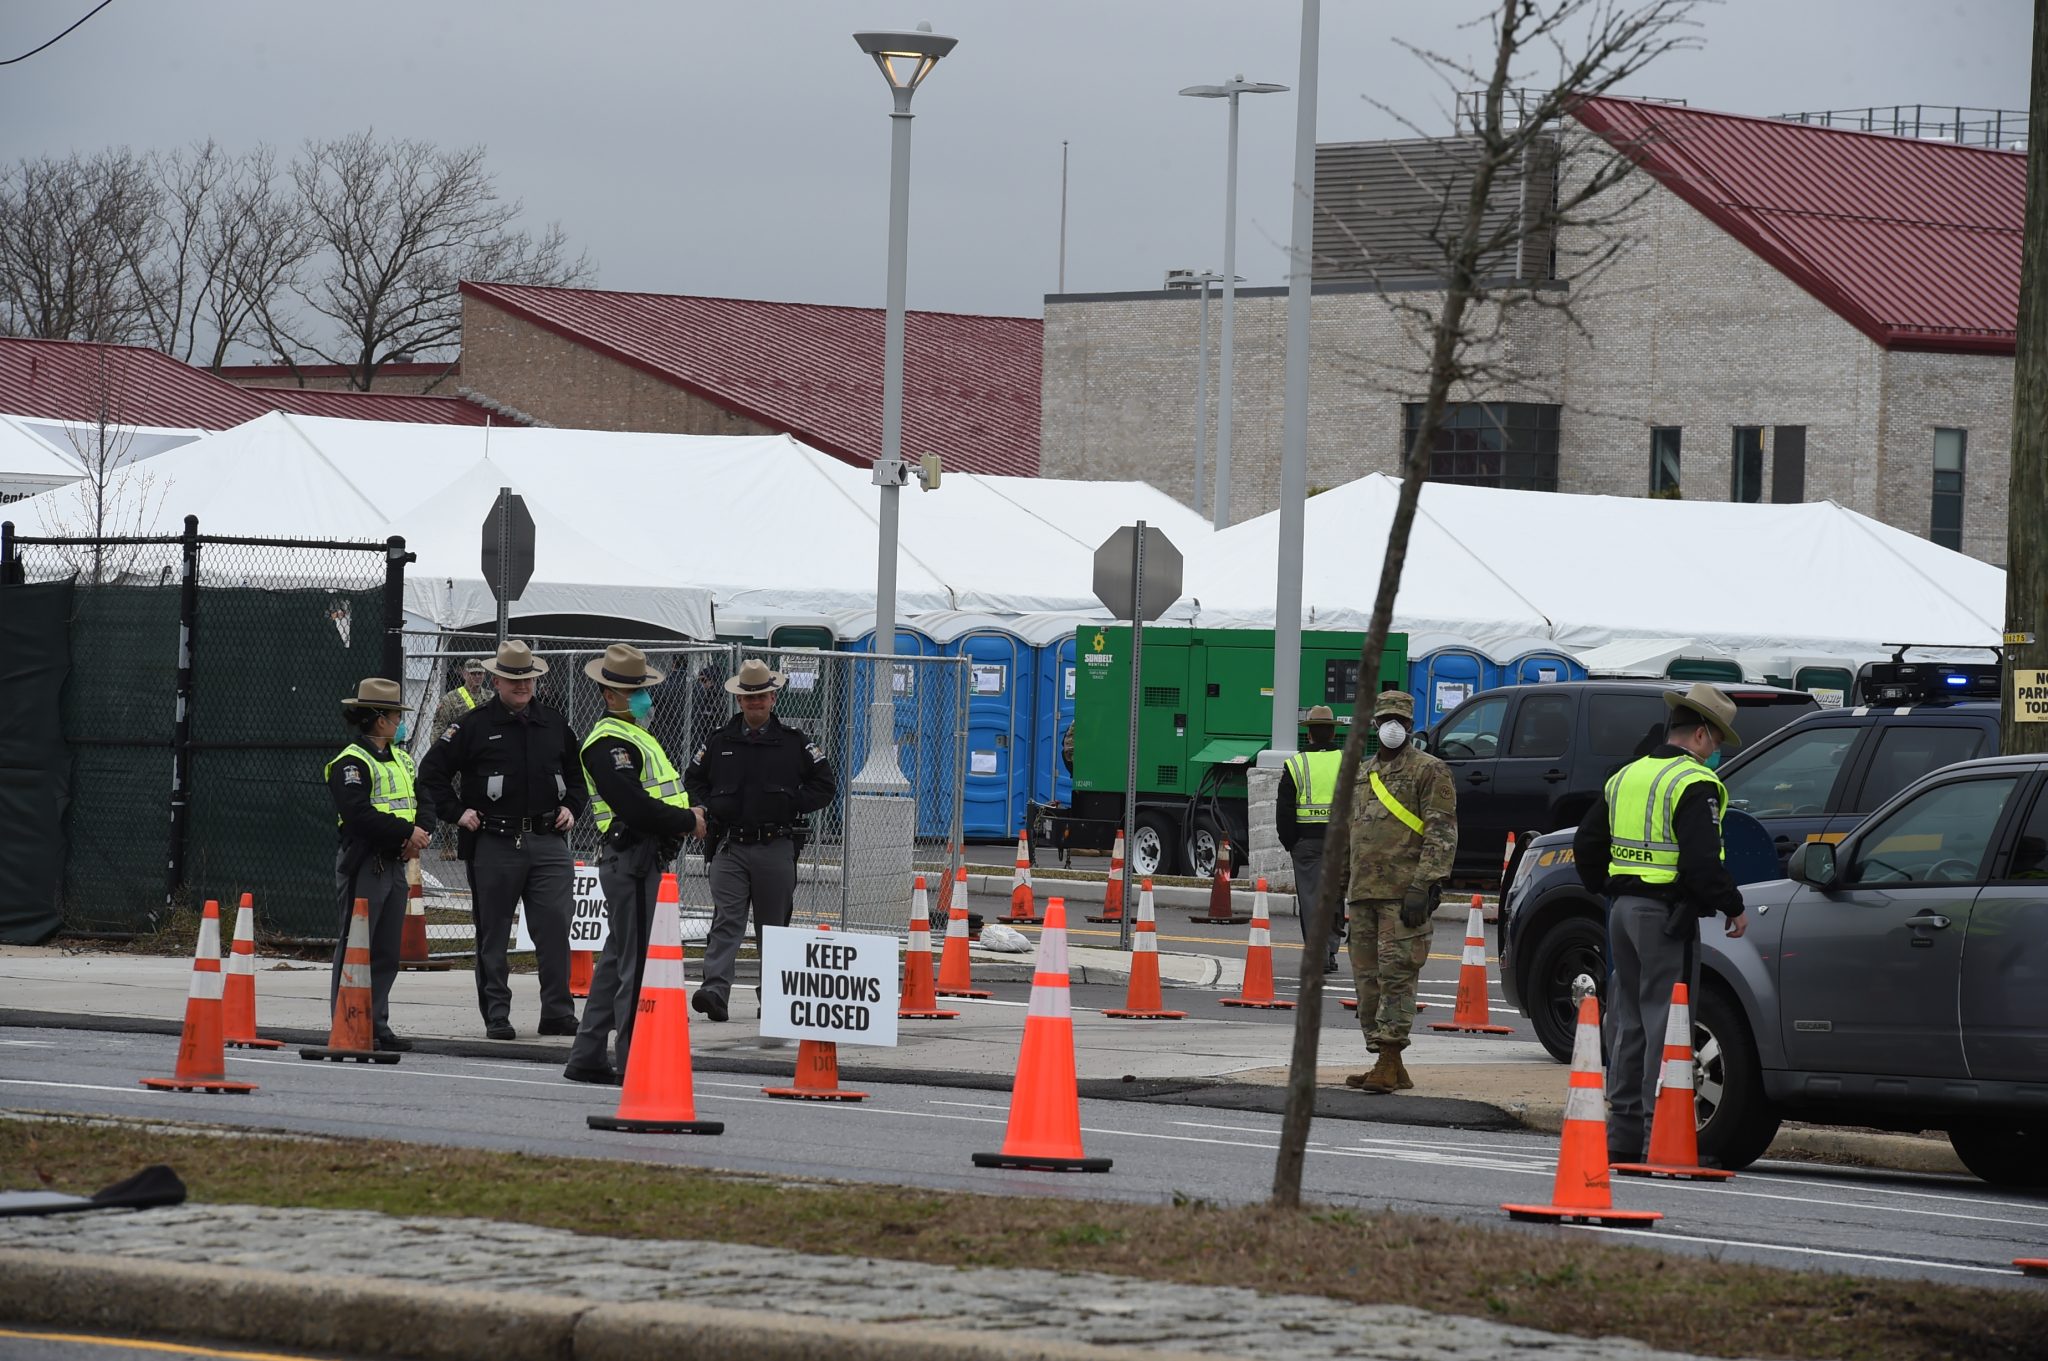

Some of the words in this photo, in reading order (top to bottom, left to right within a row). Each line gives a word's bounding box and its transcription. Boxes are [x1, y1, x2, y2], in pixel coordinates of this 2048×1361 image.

[1085, 654, 1112, 662] SUNBELT
[2025, 701, 2048, 714] TOD
[1612, 845, 1653, 862] ROOPER
[571, 921, 602, 941] SED
[806, 943, 857, 971] KEEP
[781, 970, 881, 1003] WINDOWS
[790, 1000, 870, 1031] CLOSED
